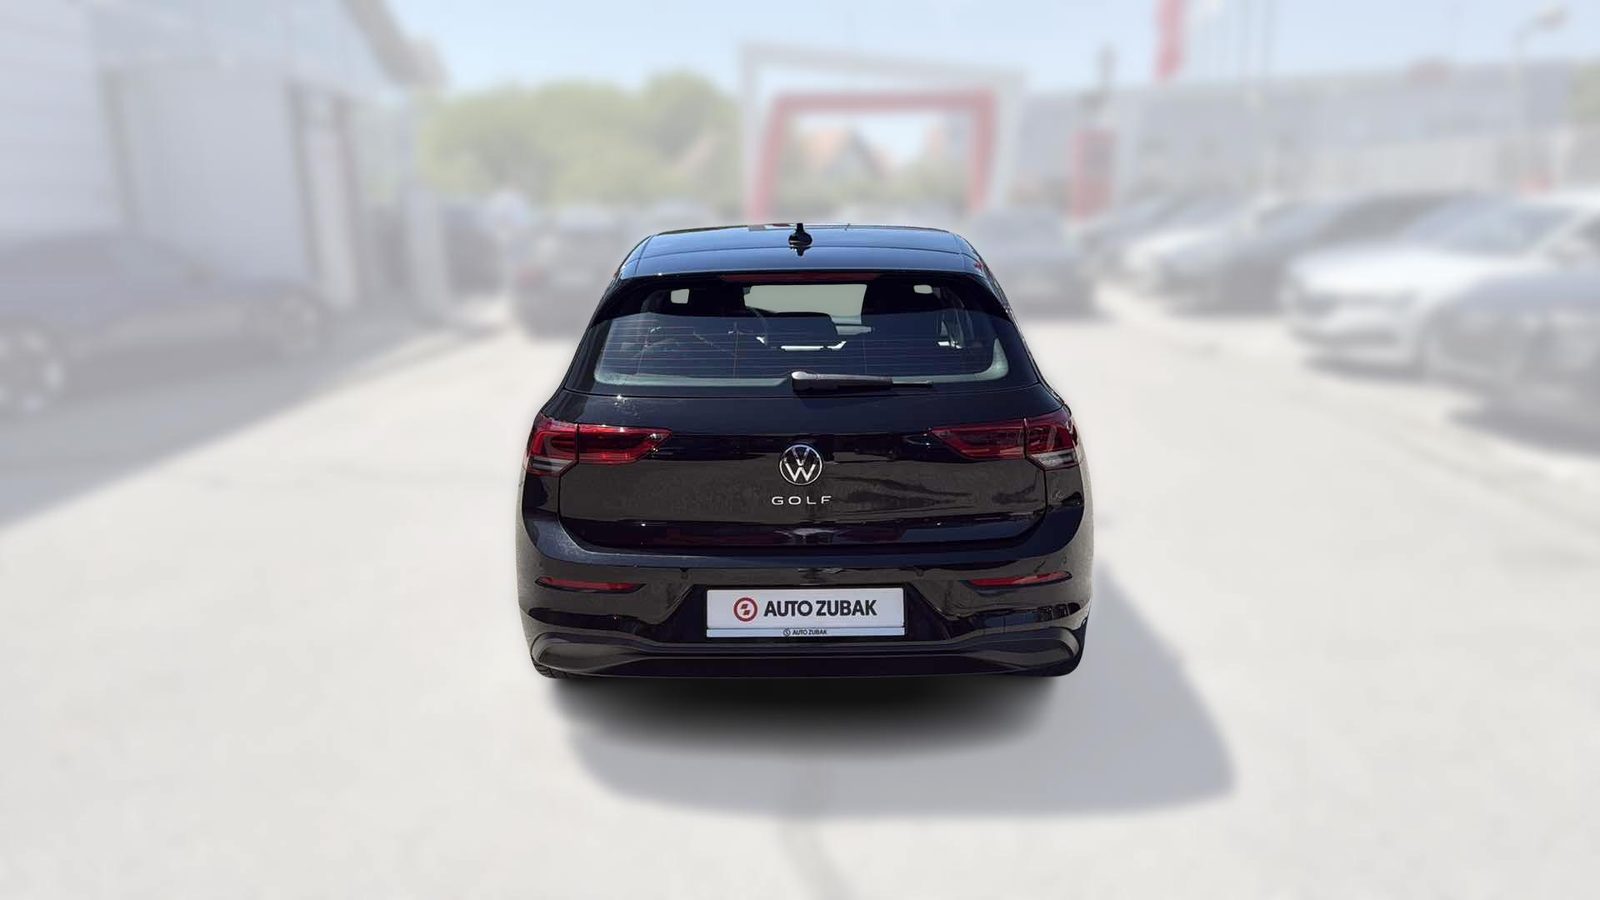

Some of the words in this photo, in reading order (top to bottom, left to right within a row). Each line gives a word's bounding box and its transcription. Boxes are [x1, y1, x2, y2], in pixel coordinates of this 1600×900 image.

[771, 495, 832, 506] GOLF
[763, 600, 812, 617] AUTO
[815, 600, 878, 617] ZUBAK
